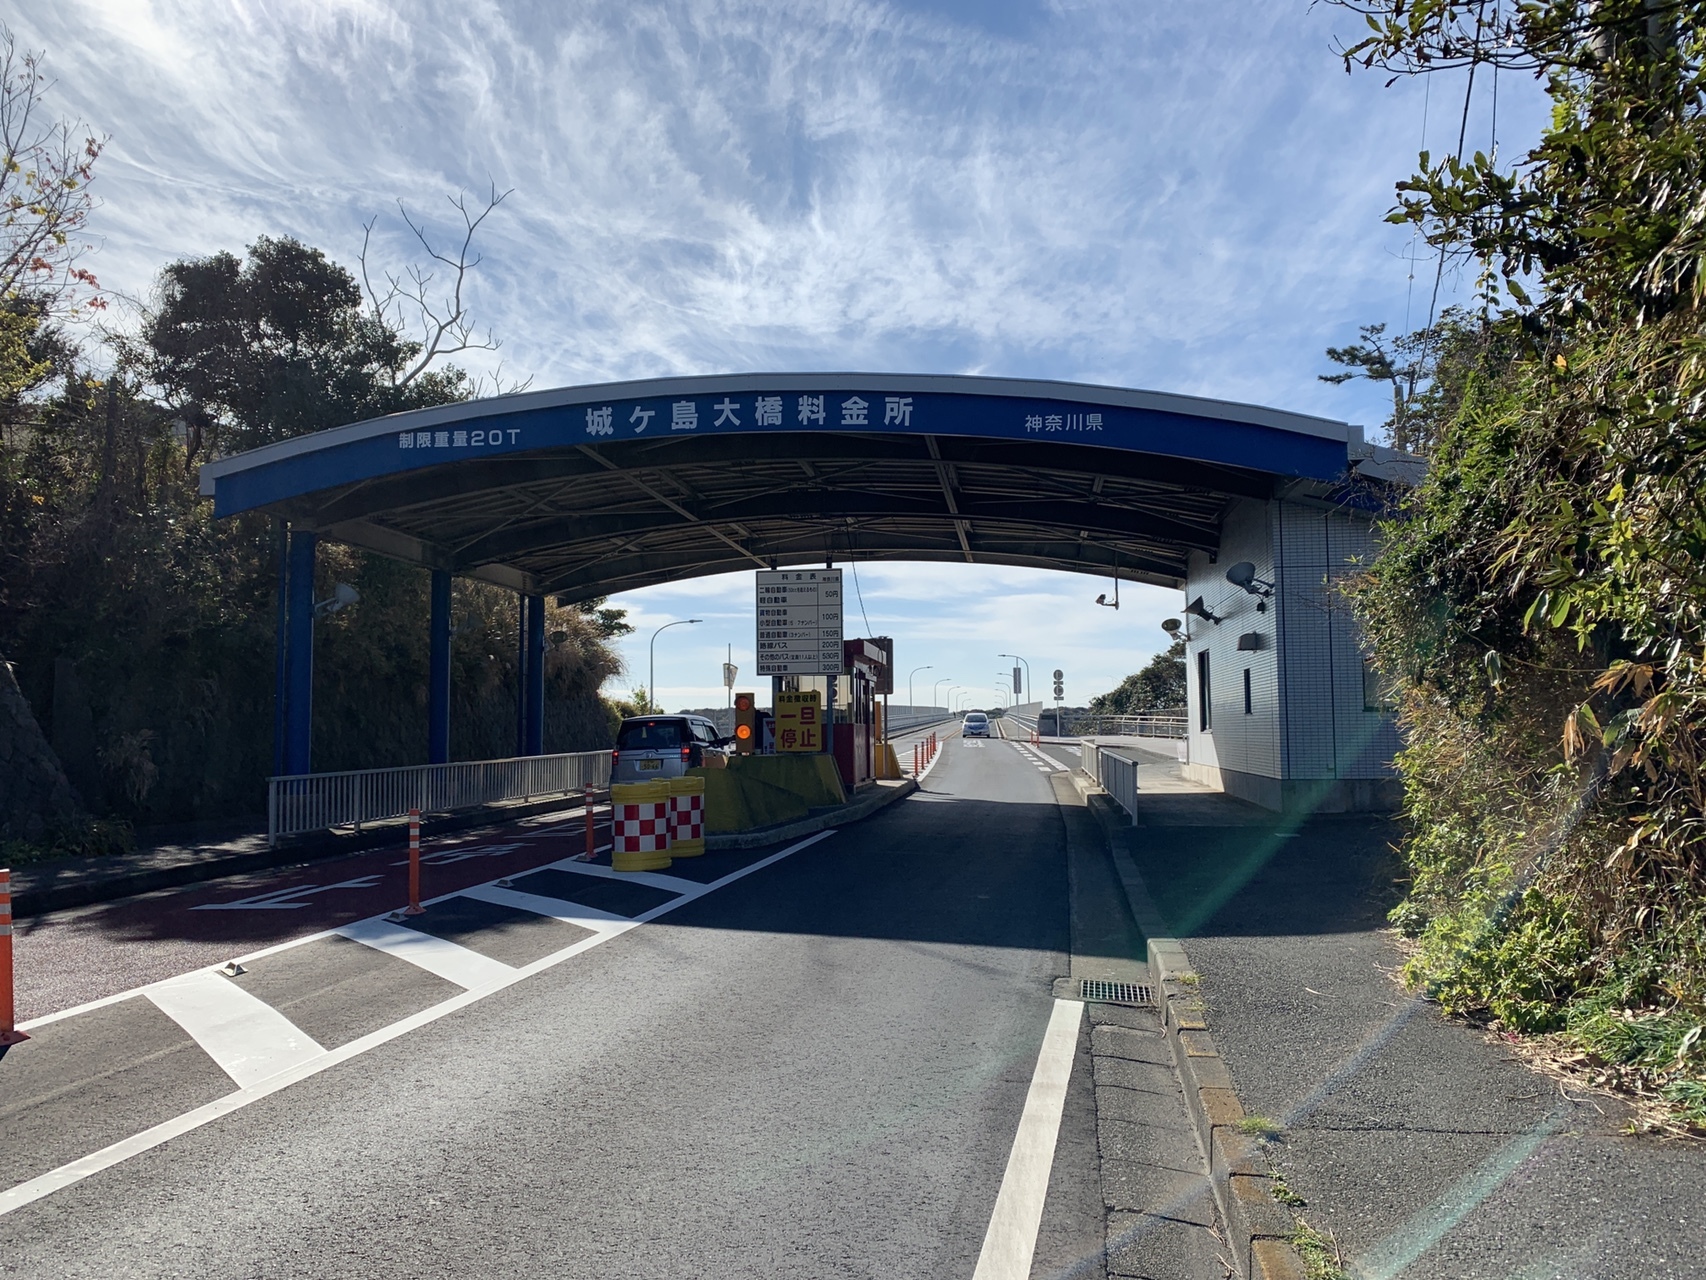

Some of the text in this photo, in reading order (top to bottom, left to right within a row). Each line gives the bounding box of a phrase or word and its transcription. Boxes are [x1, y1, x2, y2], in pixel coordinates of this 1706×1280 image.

[1025, 413, 1103, 432] 神奈川県
[399, 429, 520, 449] 制限重量20T
[782, 573, 816, 581] 料金表
[760, 596, 787, 604] 軽自動車
[760, 642, 788, 650] 路線バス
[822, 641, 839, 649] 200円
[760, 653, 789, 661] その他のバス
[778, 694, 816, 703] 料金徴収時
[780, 706, 816, 725] 一旦
[780, 728, 817, 749] 停止
